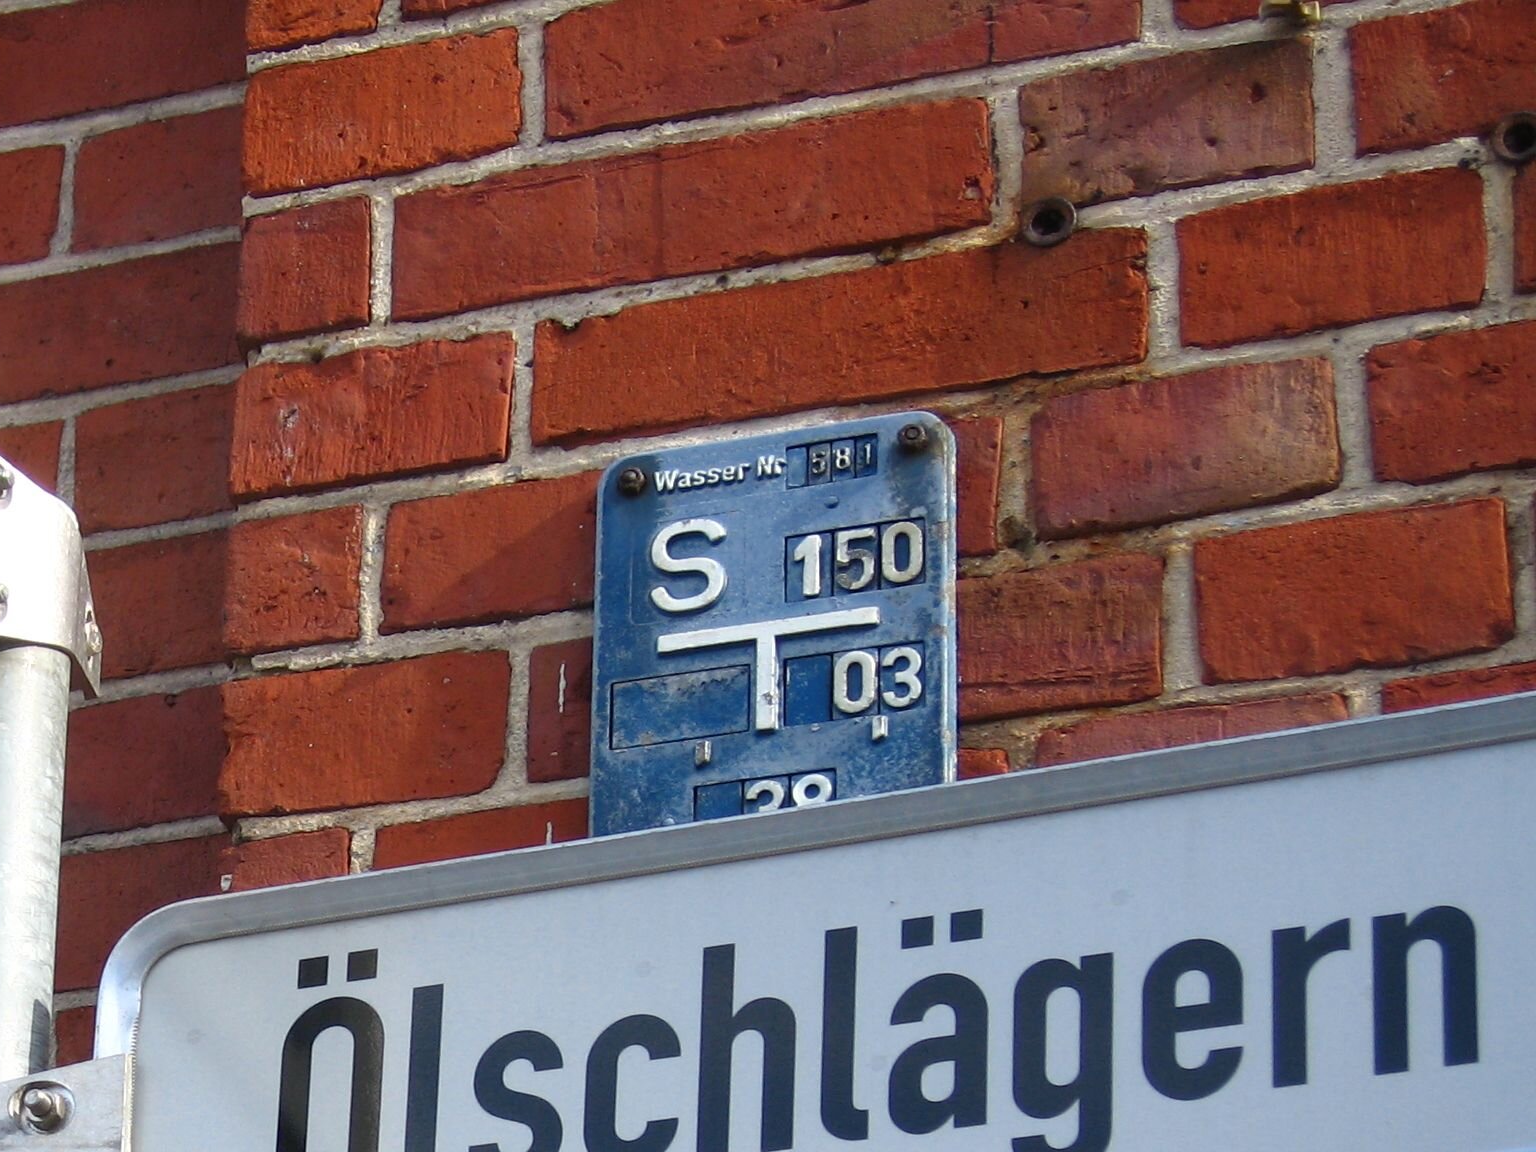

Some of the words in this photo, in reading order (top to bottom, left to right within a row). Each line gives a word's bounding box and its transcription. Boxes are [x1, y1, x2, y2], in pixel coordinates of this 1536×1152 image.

[654, 461, 751, 492] Wasser
[811, 442, 872, 475] 581
[650, 518, 728, 613] S
[792, 521, 924, 598] 150
[832, 646, 923, 714] 03
